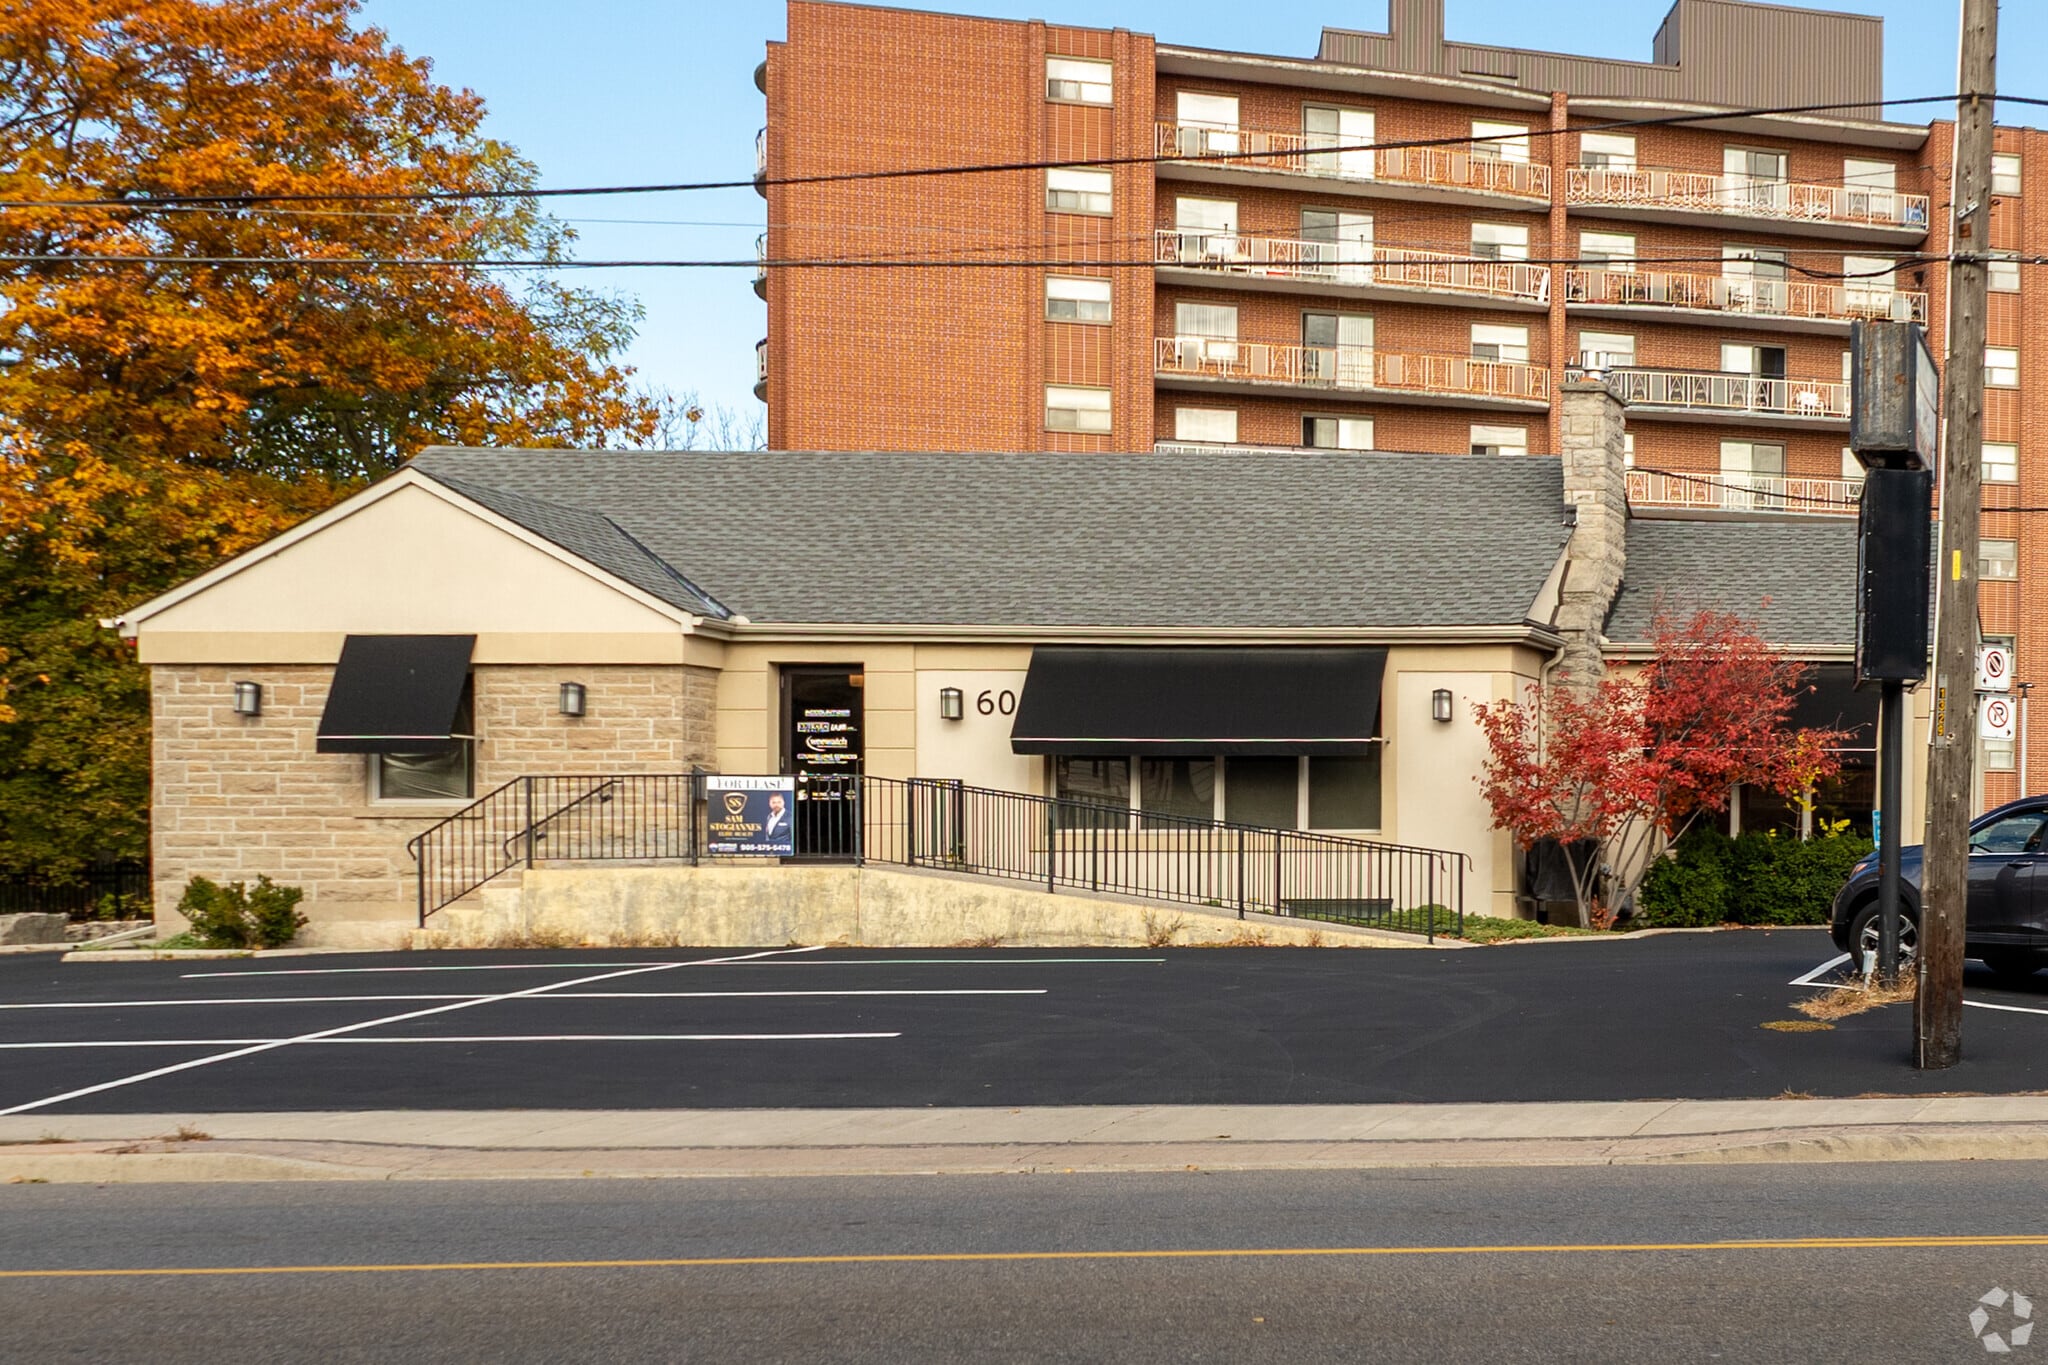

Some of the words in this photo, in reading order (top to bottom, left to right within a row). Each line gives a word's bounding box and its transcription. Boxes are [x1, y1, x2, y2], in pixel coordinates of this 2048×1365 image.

[977, 690, 1016, 715] 60
[717, 778, 742, 789] FOR
[746, 778, 785, 789] LEASE
[725, 814, 743, 823] SAM
